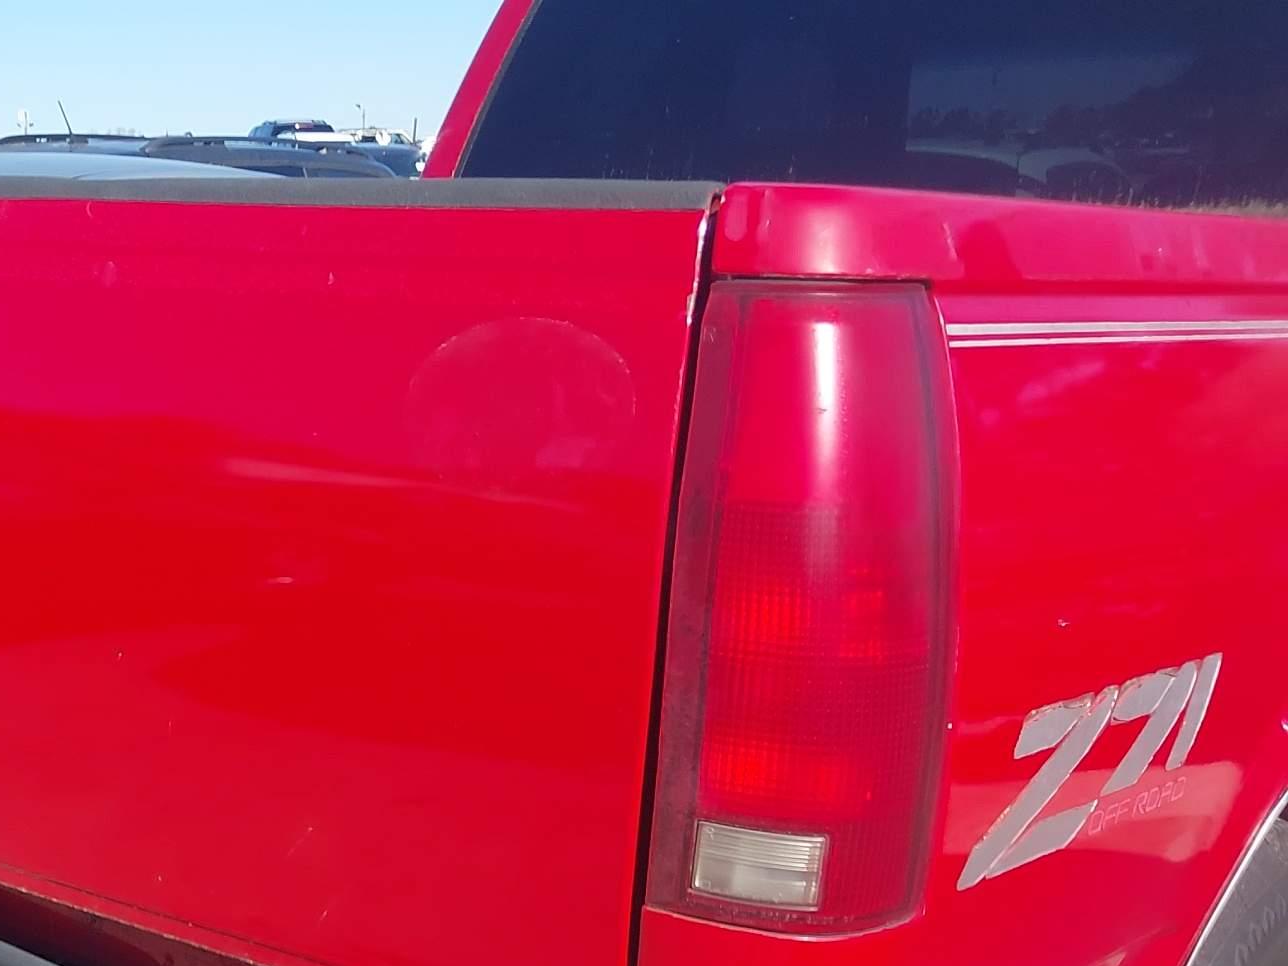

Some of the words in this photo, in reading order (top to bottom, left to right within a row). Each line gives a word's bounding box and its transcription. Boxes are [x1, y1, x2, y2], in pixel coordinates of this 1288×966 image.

[956, 652, 1223, 891] Z71
[1087, 798, 1131, 836] OFF
[1131, 776, 1187, 818] ROAD
